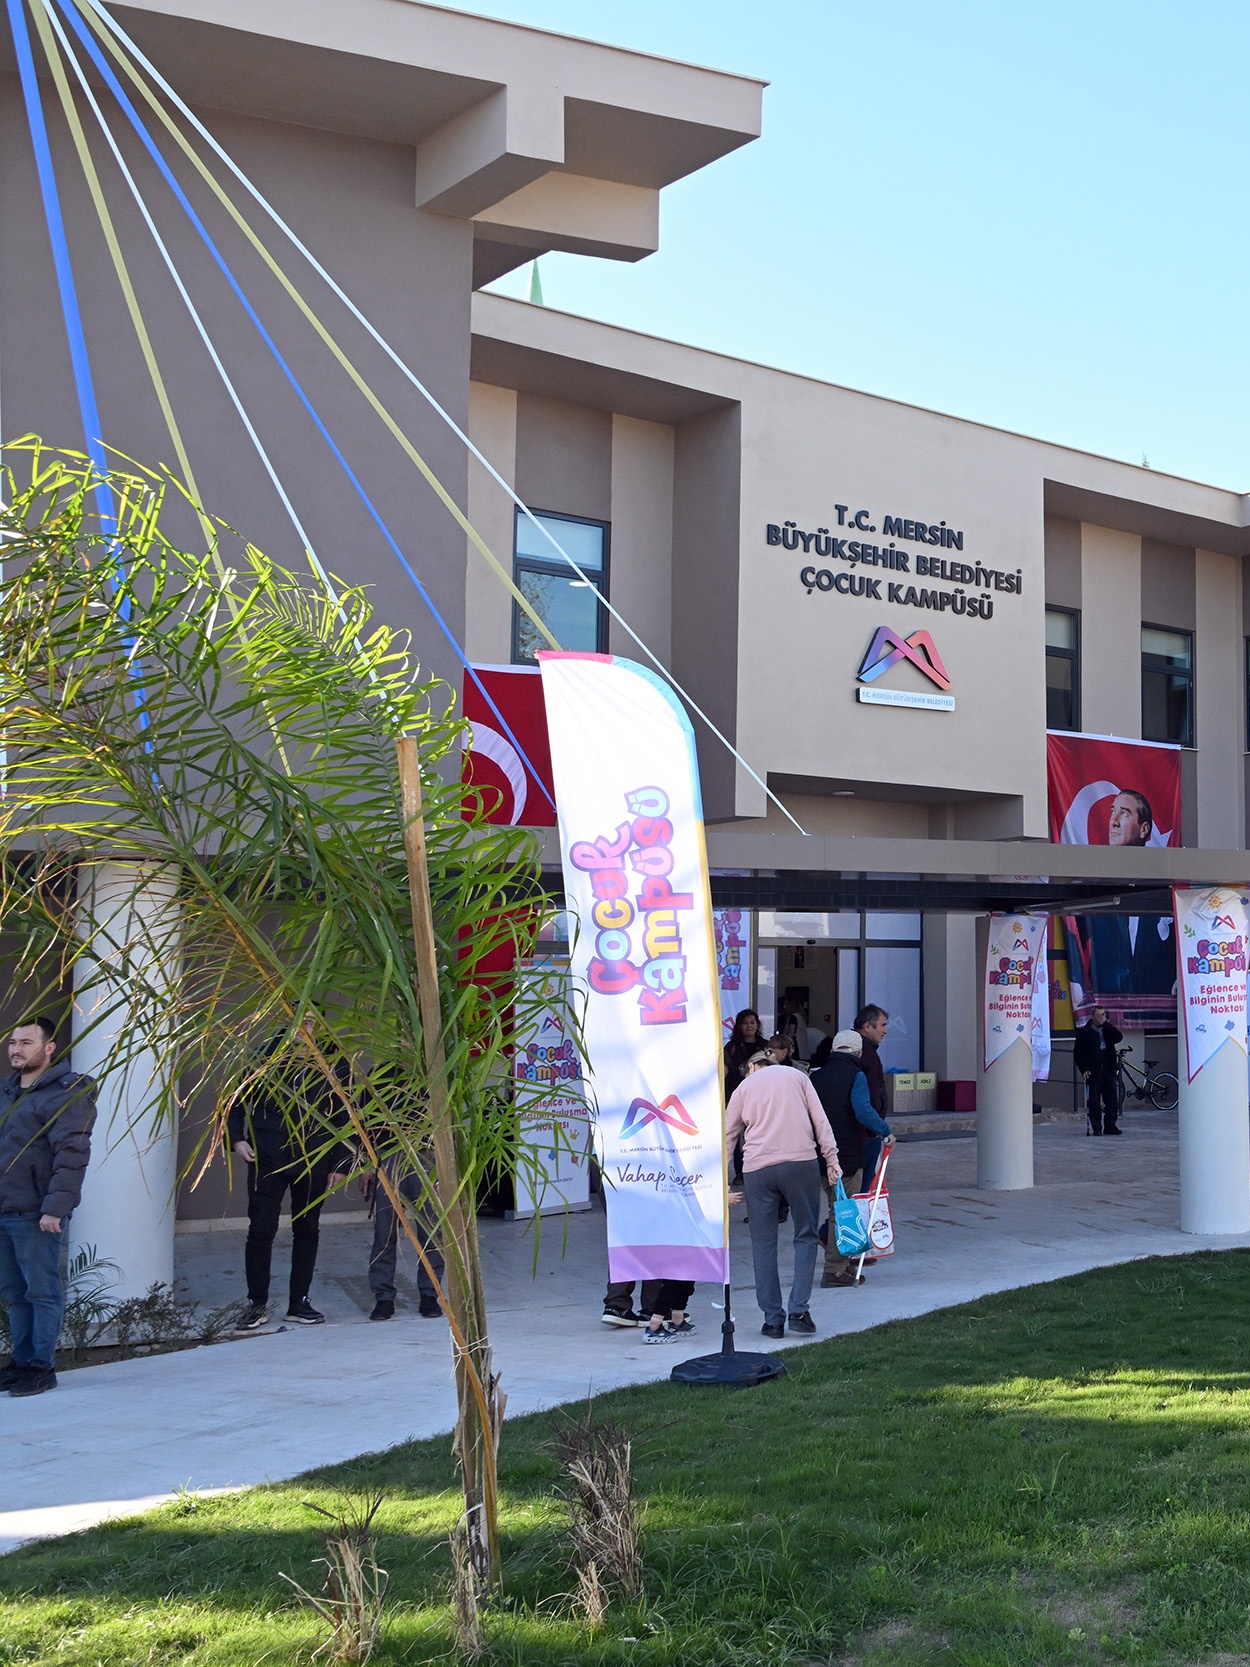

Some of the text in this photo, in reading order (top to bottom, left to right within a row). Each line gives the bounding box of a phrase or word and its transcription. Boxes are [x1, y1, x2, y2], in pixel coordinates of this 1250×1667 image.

[835, 504, 963, 551] T.C. MERSİN
[767, 521, 1022, 594] BÜYÜKŞEHİR BELEDİYESİ
[801, 566, 993, 620] ÇOCUK KAMPÜSÜ
[872, 692, 892, 701] MERSİN
[893, 693, 926, 704] BÜYÜKŞEHİR
[926, 698, 954, 707] BELEDİYESİ
[570, 820, 641, 995] Çocuk
[624, 785, 694, 1025] Kampüsü
[1187, 955, 1246, 978] Kampü
[989, 970, 1032, 990] Kamp
[1200, 984, 1239, 995] Eğlence
[989, 1002, 1018, 1011] Bilginin
[1189, 994, 1247, 1006] Bilginin Bulu
[617, 1163, 666, 1192] Vahap
[669, 1165, 703, 1188] Seçer
